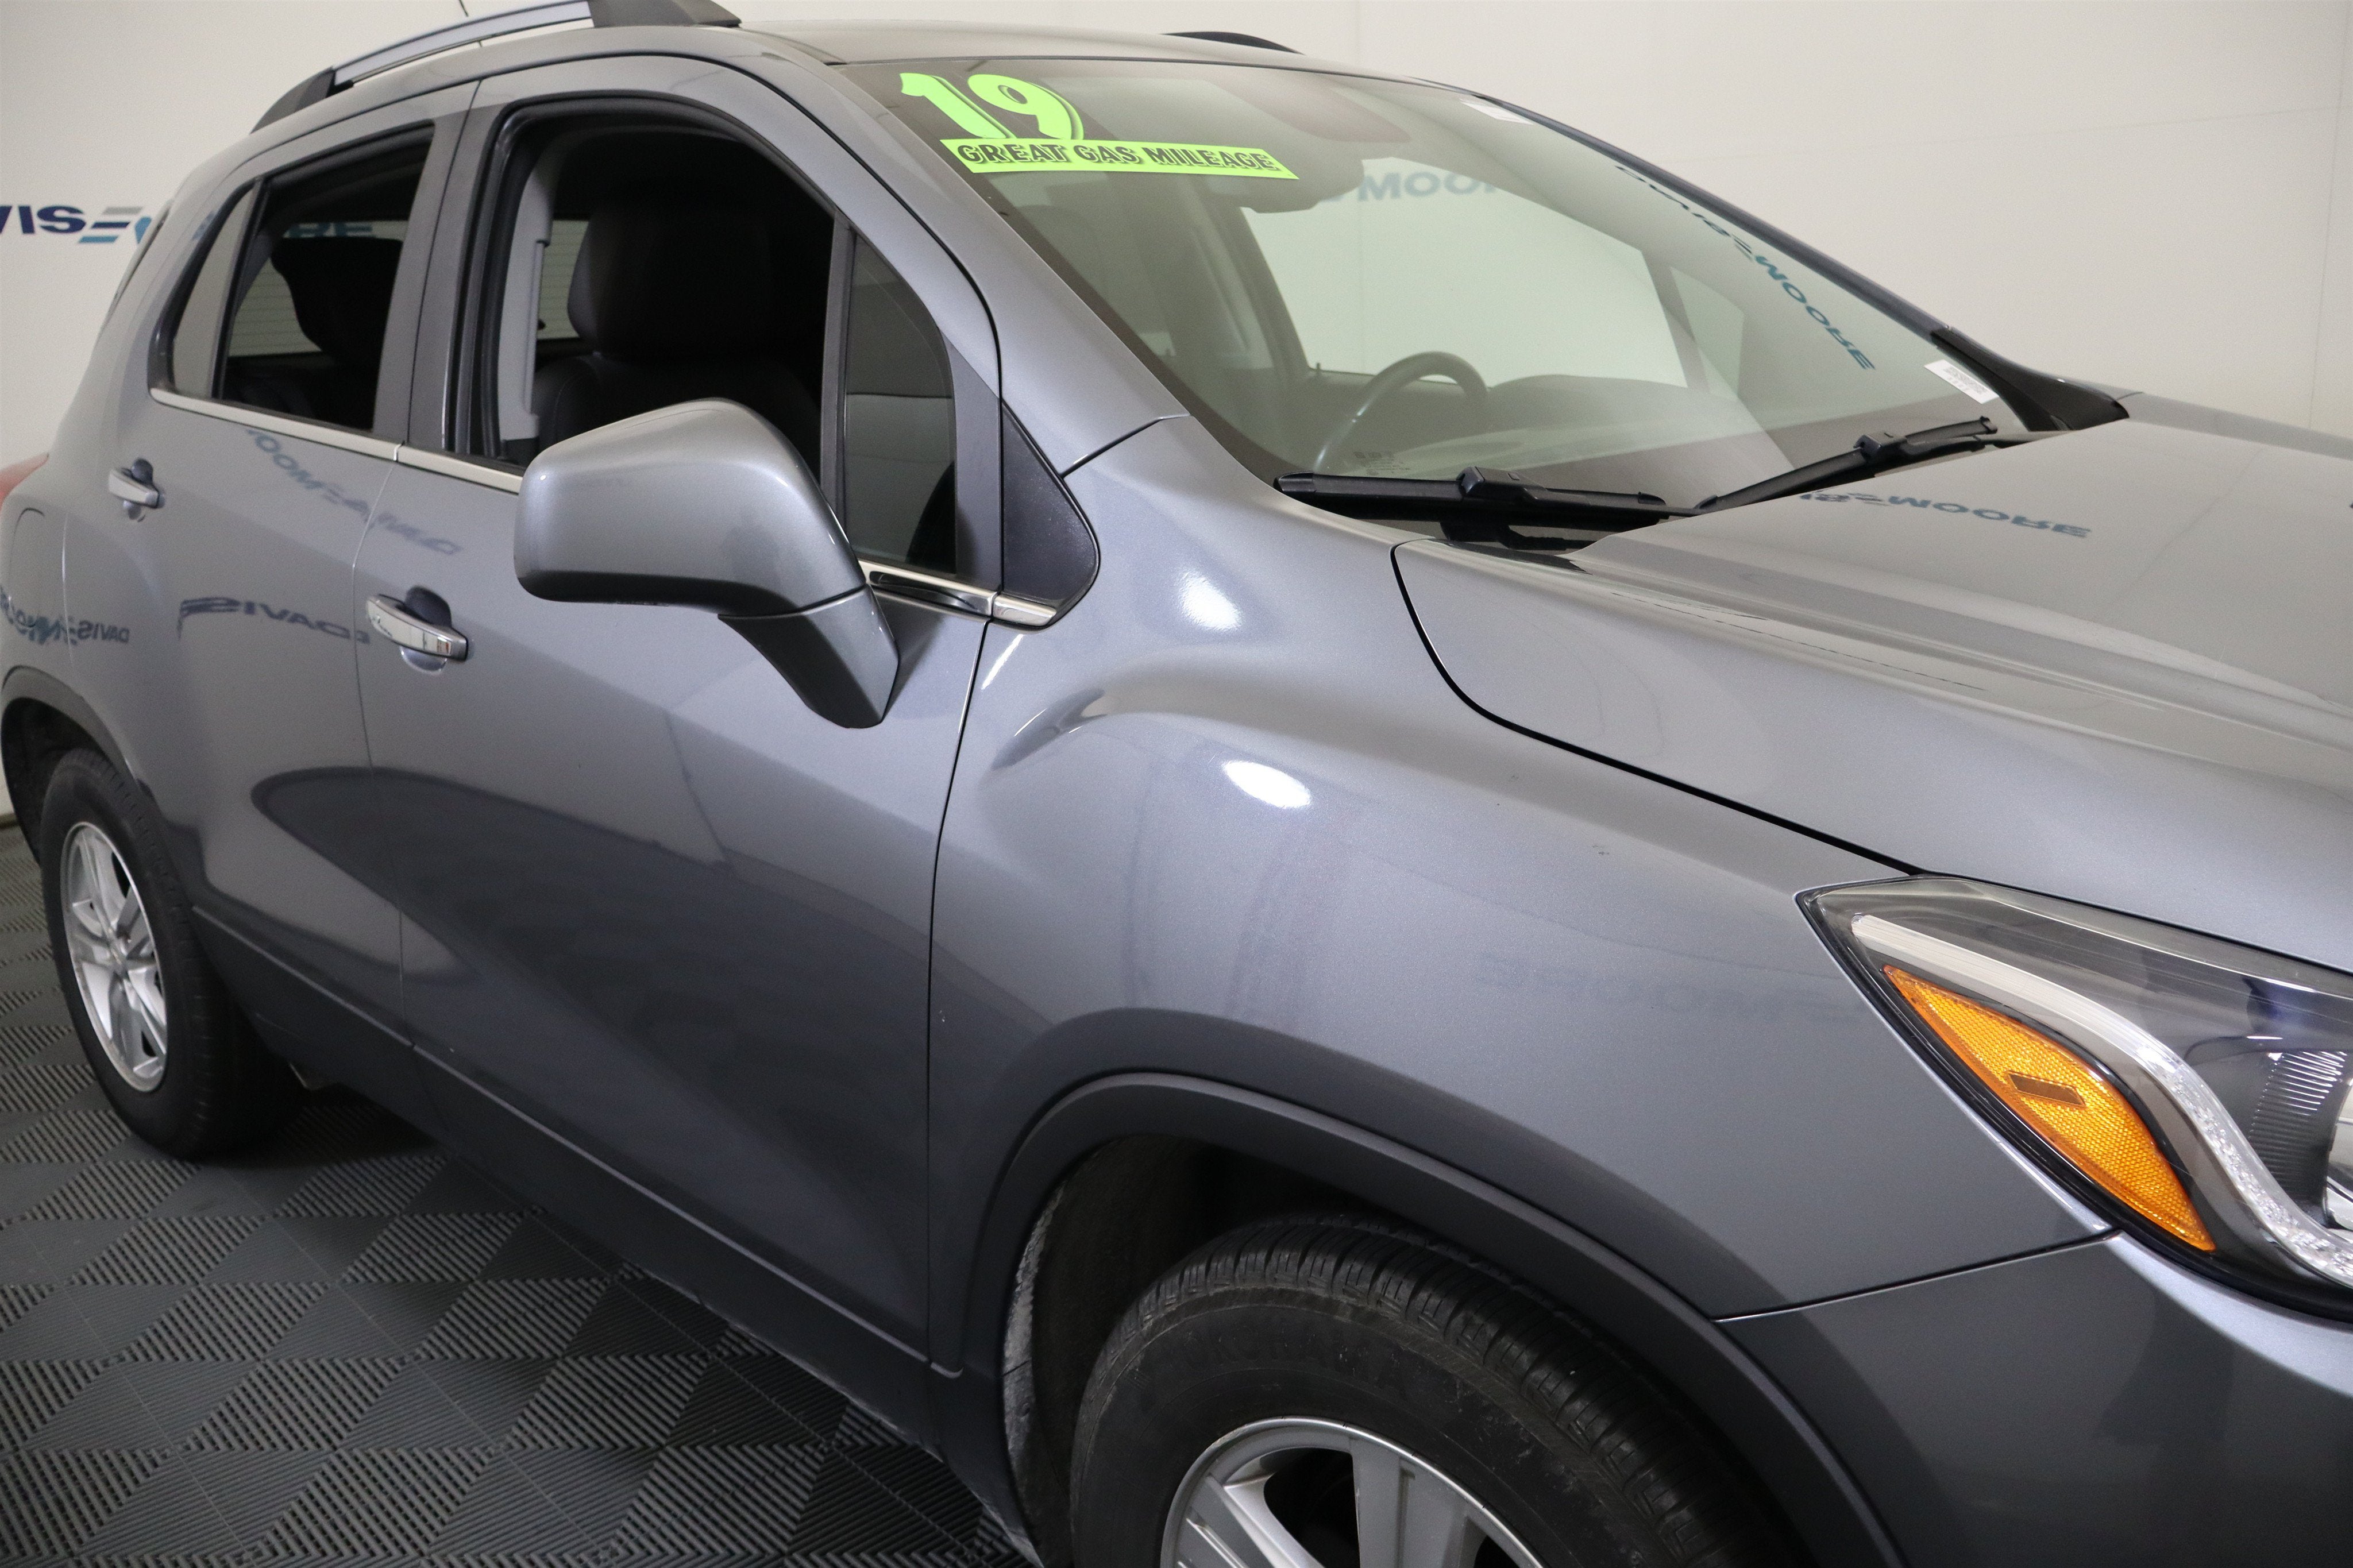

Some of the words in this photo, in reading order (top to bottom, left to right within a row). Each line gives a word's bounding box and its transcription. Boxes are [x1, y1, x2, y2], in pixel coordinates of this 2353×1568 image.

[899, 72, 1084, 140] 19
[958, 144, 1069, 164] GREAT
[1073, 145, 1144, 165] GAS
[1141, 146, 1281, 171] MILEAGE
